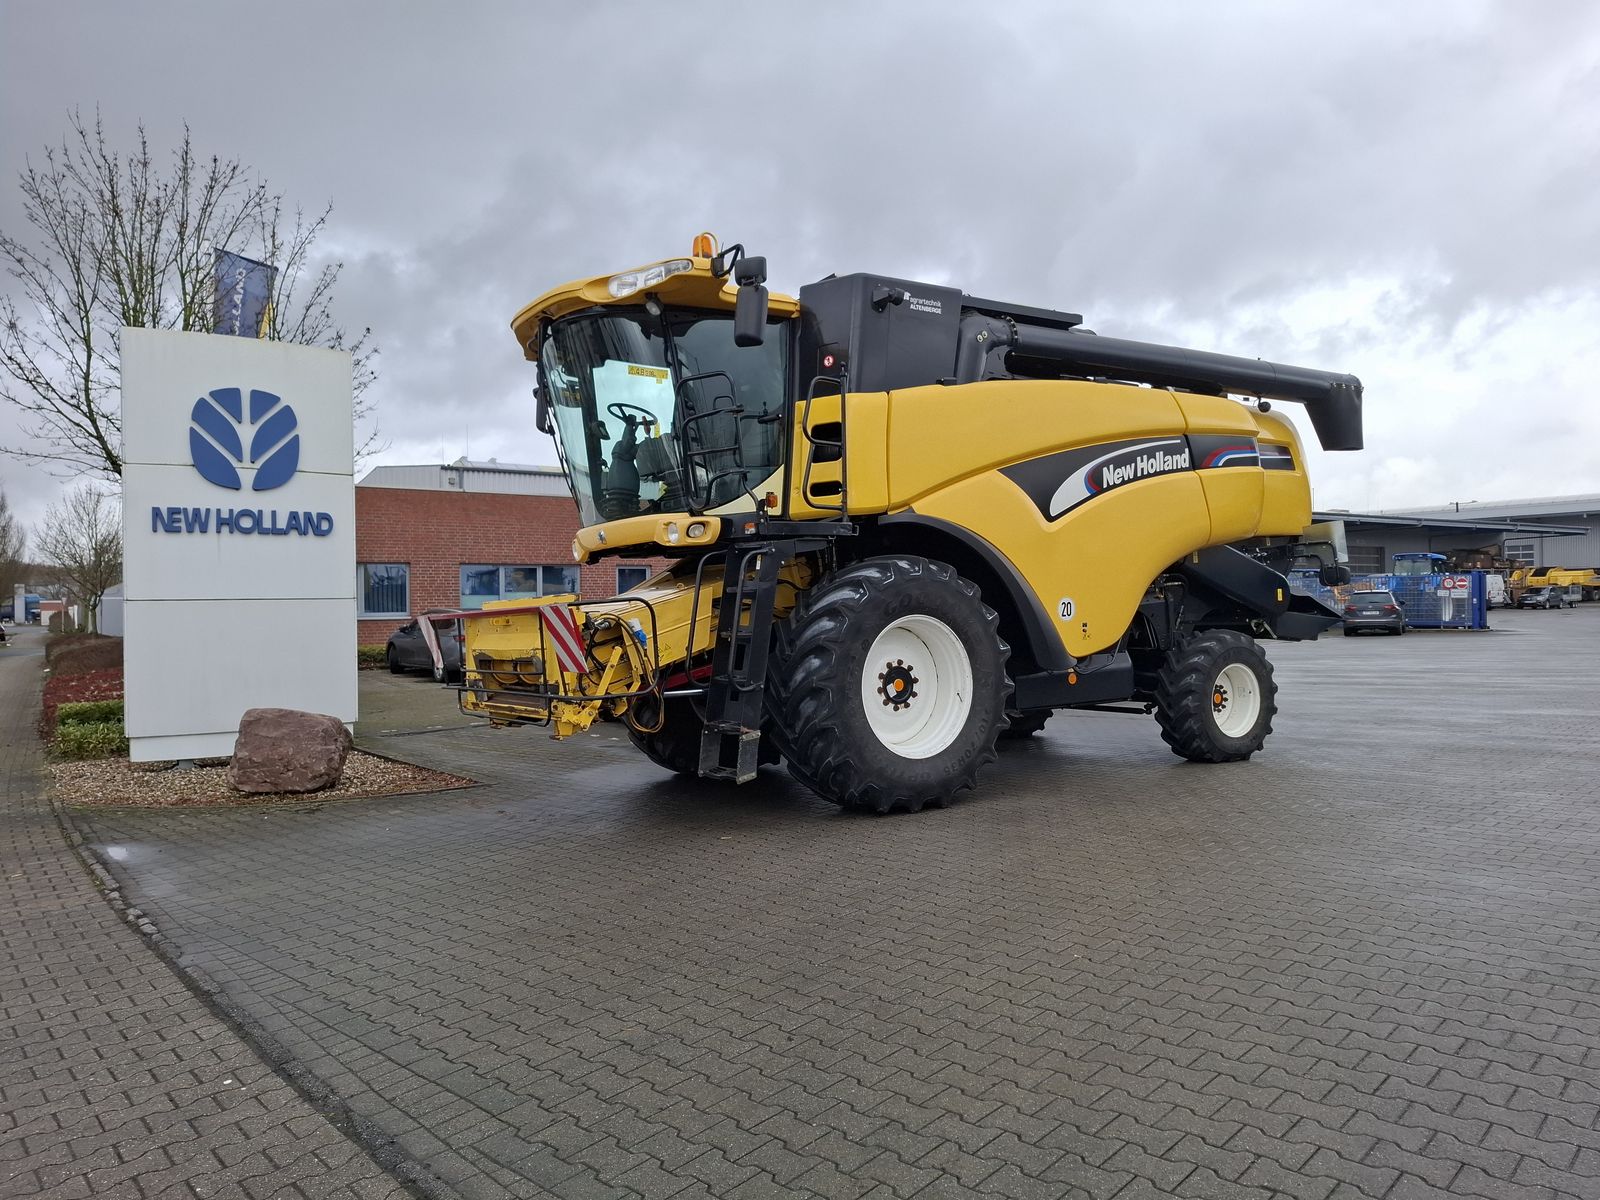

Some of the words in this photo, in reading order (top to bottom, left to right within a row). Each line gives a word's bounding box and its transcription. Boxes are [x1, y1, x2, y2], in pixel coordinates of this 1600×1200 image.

[910, 303, 942, 314] ALTENBERGE
[1102, 463, 1135, 488] New
[1136, 448, 1189, 477] Holland
[151, 506, 211, 534] NEW
[215, 508, 334, 537] HOLLAND
[1061, 601, 1072, 617] 20
